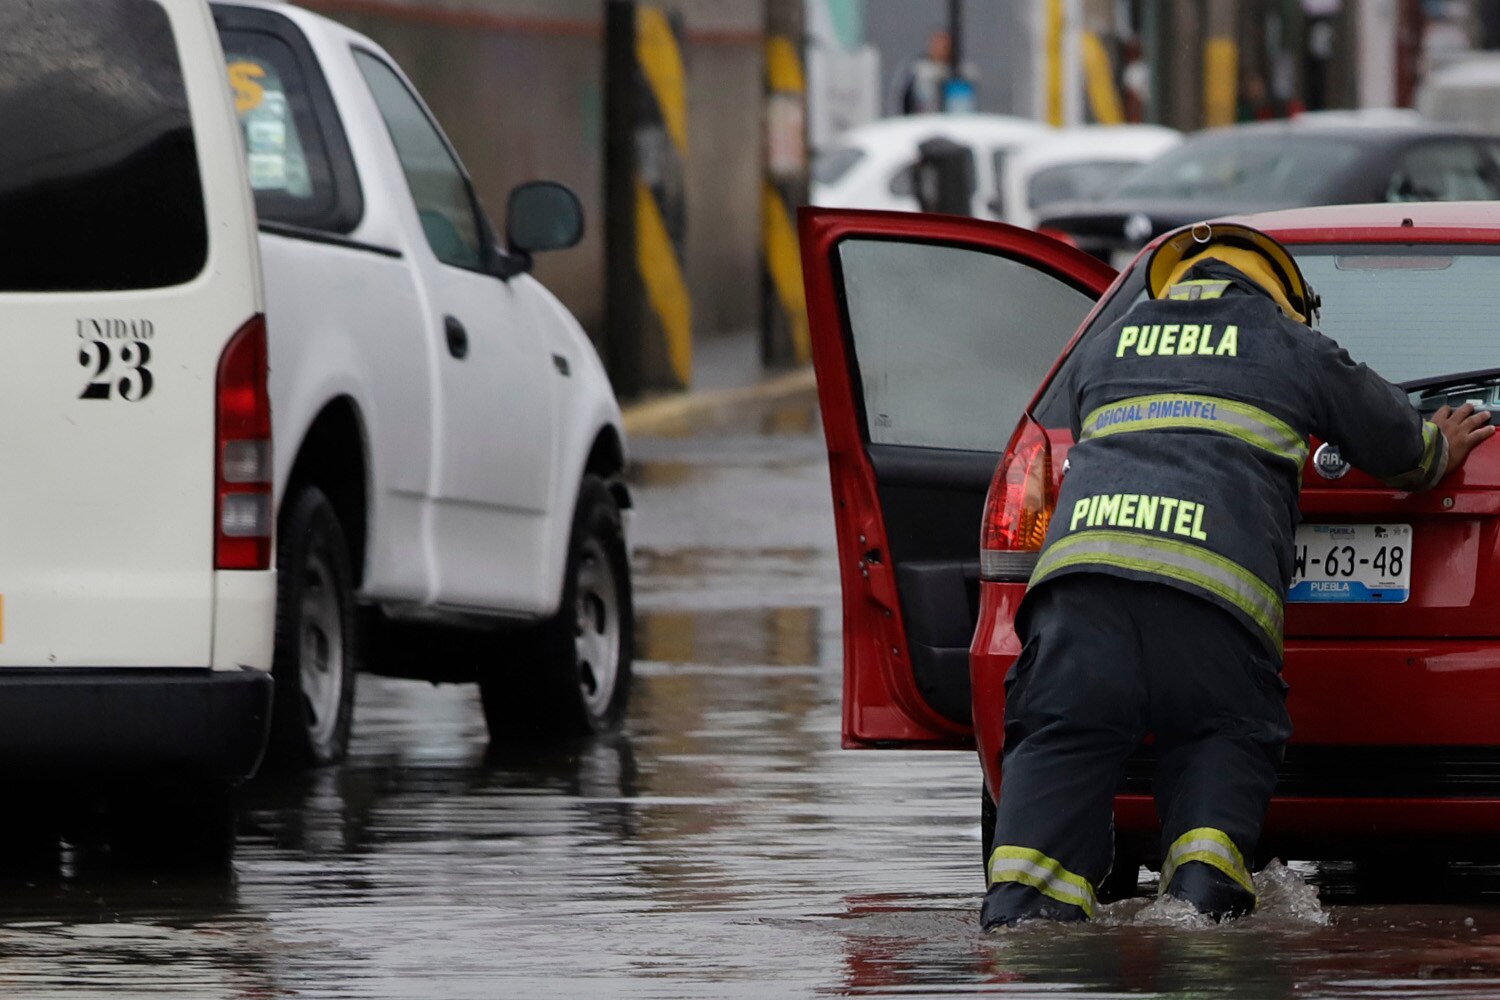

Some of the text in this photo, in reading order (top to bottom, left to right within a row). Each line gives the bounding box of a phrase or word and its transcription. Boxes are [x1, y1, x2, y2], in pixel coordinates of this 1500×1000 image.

[76, 318, 154, 339] UNIDAD
[1116, 324, 1239, 358] PUEBLA
[78, 341, 154, 402] 23
[1095, 400, 1217, 431] OFICIAL PIMENTEL
[1069, 493, 1207, 541] PIMENTEL
[1310, 582, 1350, 592] PUEBLA
